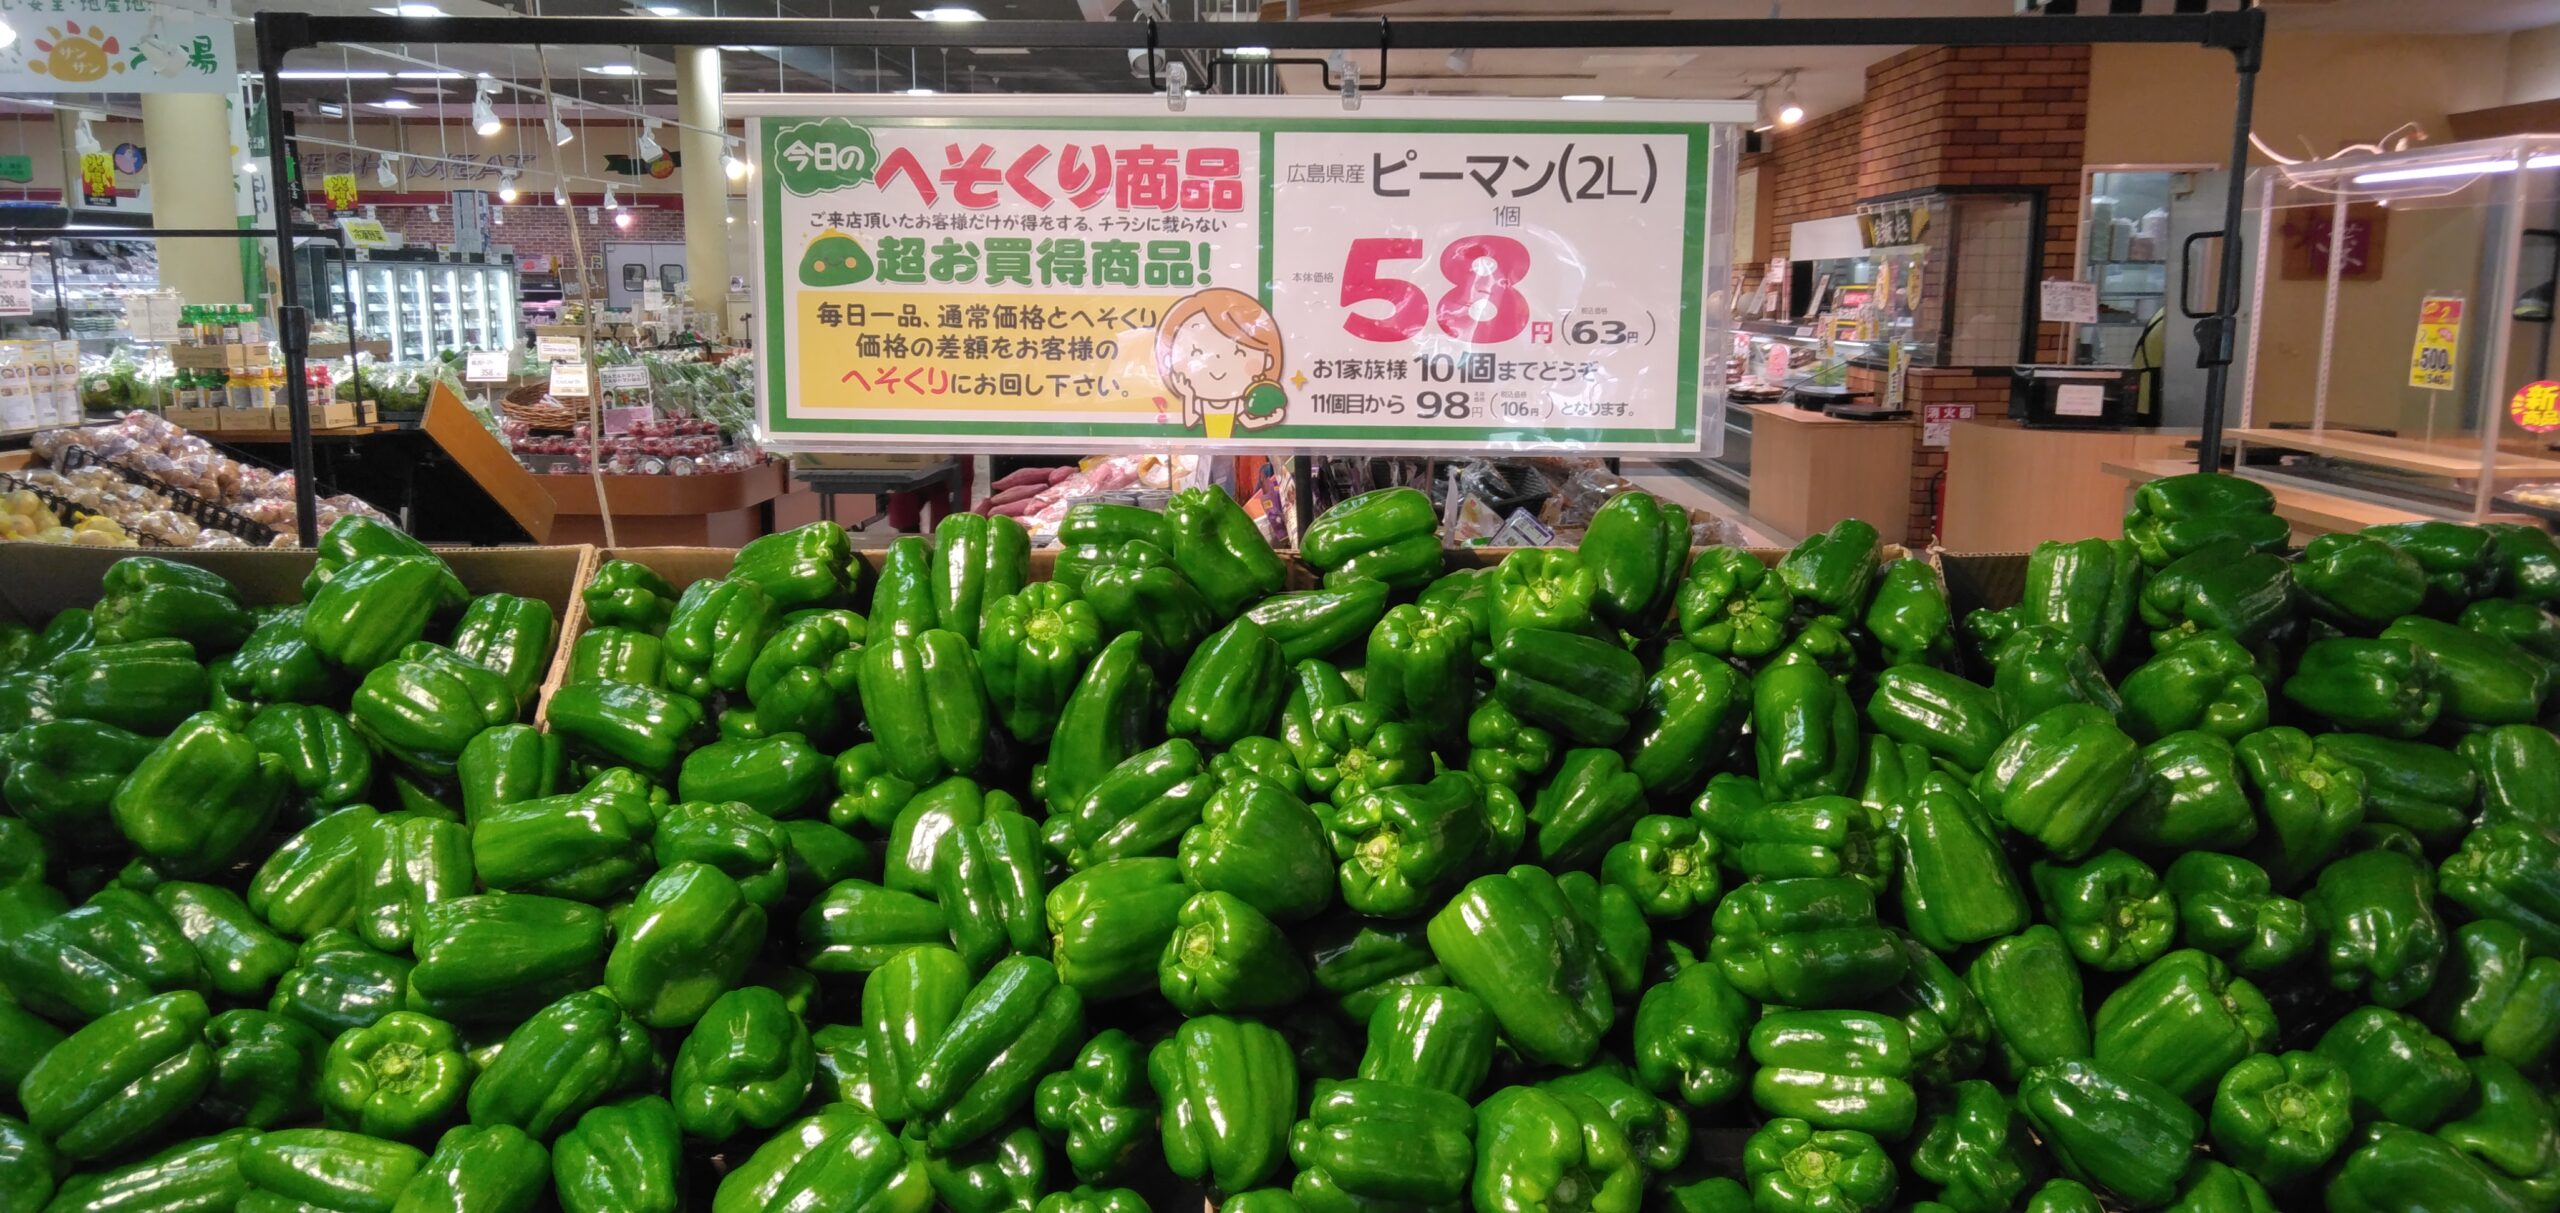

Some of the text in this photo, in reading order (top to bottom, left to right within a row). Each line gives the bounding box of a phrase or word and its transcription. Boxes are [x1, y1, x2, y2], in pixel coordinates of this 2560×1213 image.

[783, 142, 865, 173] 今日の
[874, 142, 1245, 212] へそくり商品
[1287, 163, 1365, 185] 広島県産
[1492, 205, 1520, 227] 1個
[1292, 271, 1335, 284] 本体価格
[816, 302, 1158, 329] 毎日一品、通常価格とへそくり
[854, 334, 1119, 362] 価格の差額をお客様の
[840, 366, 1131, 400] へそくりにお回し下さい。
[2527, 384, 2559, 411] 新
